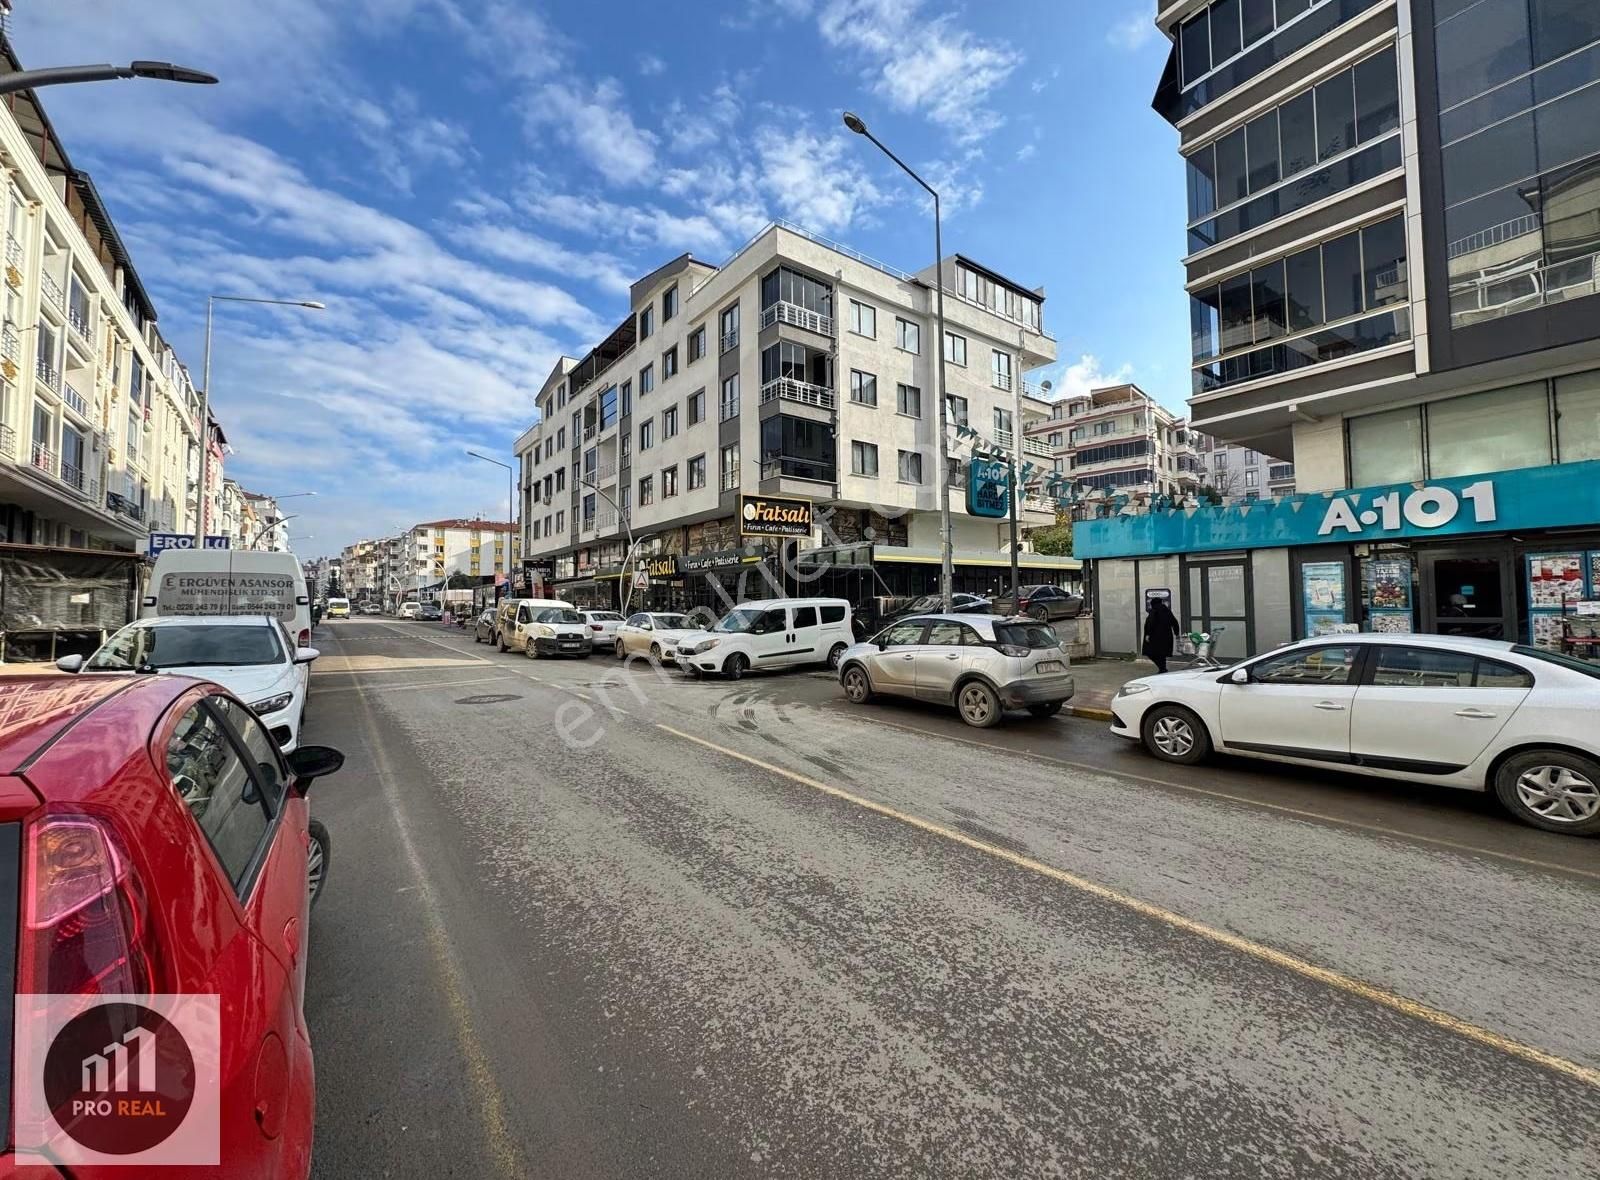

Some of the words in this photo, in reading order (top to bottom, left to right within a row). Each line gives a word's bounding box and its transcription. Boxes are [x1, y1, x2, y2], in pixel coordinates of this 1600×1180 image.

[754, 502, 810, 523] Fatsalı
[764, 524, 778, 533] Cafe
[781, 525, 808, 534] Patisserie
[644, 555, 676, 577] Fatsalı
[701, 557, 713, 569] Cafe
[179, 575, 237, 588] ERGÜVEN
[239, 576, 294, 589] ASANSÖR
